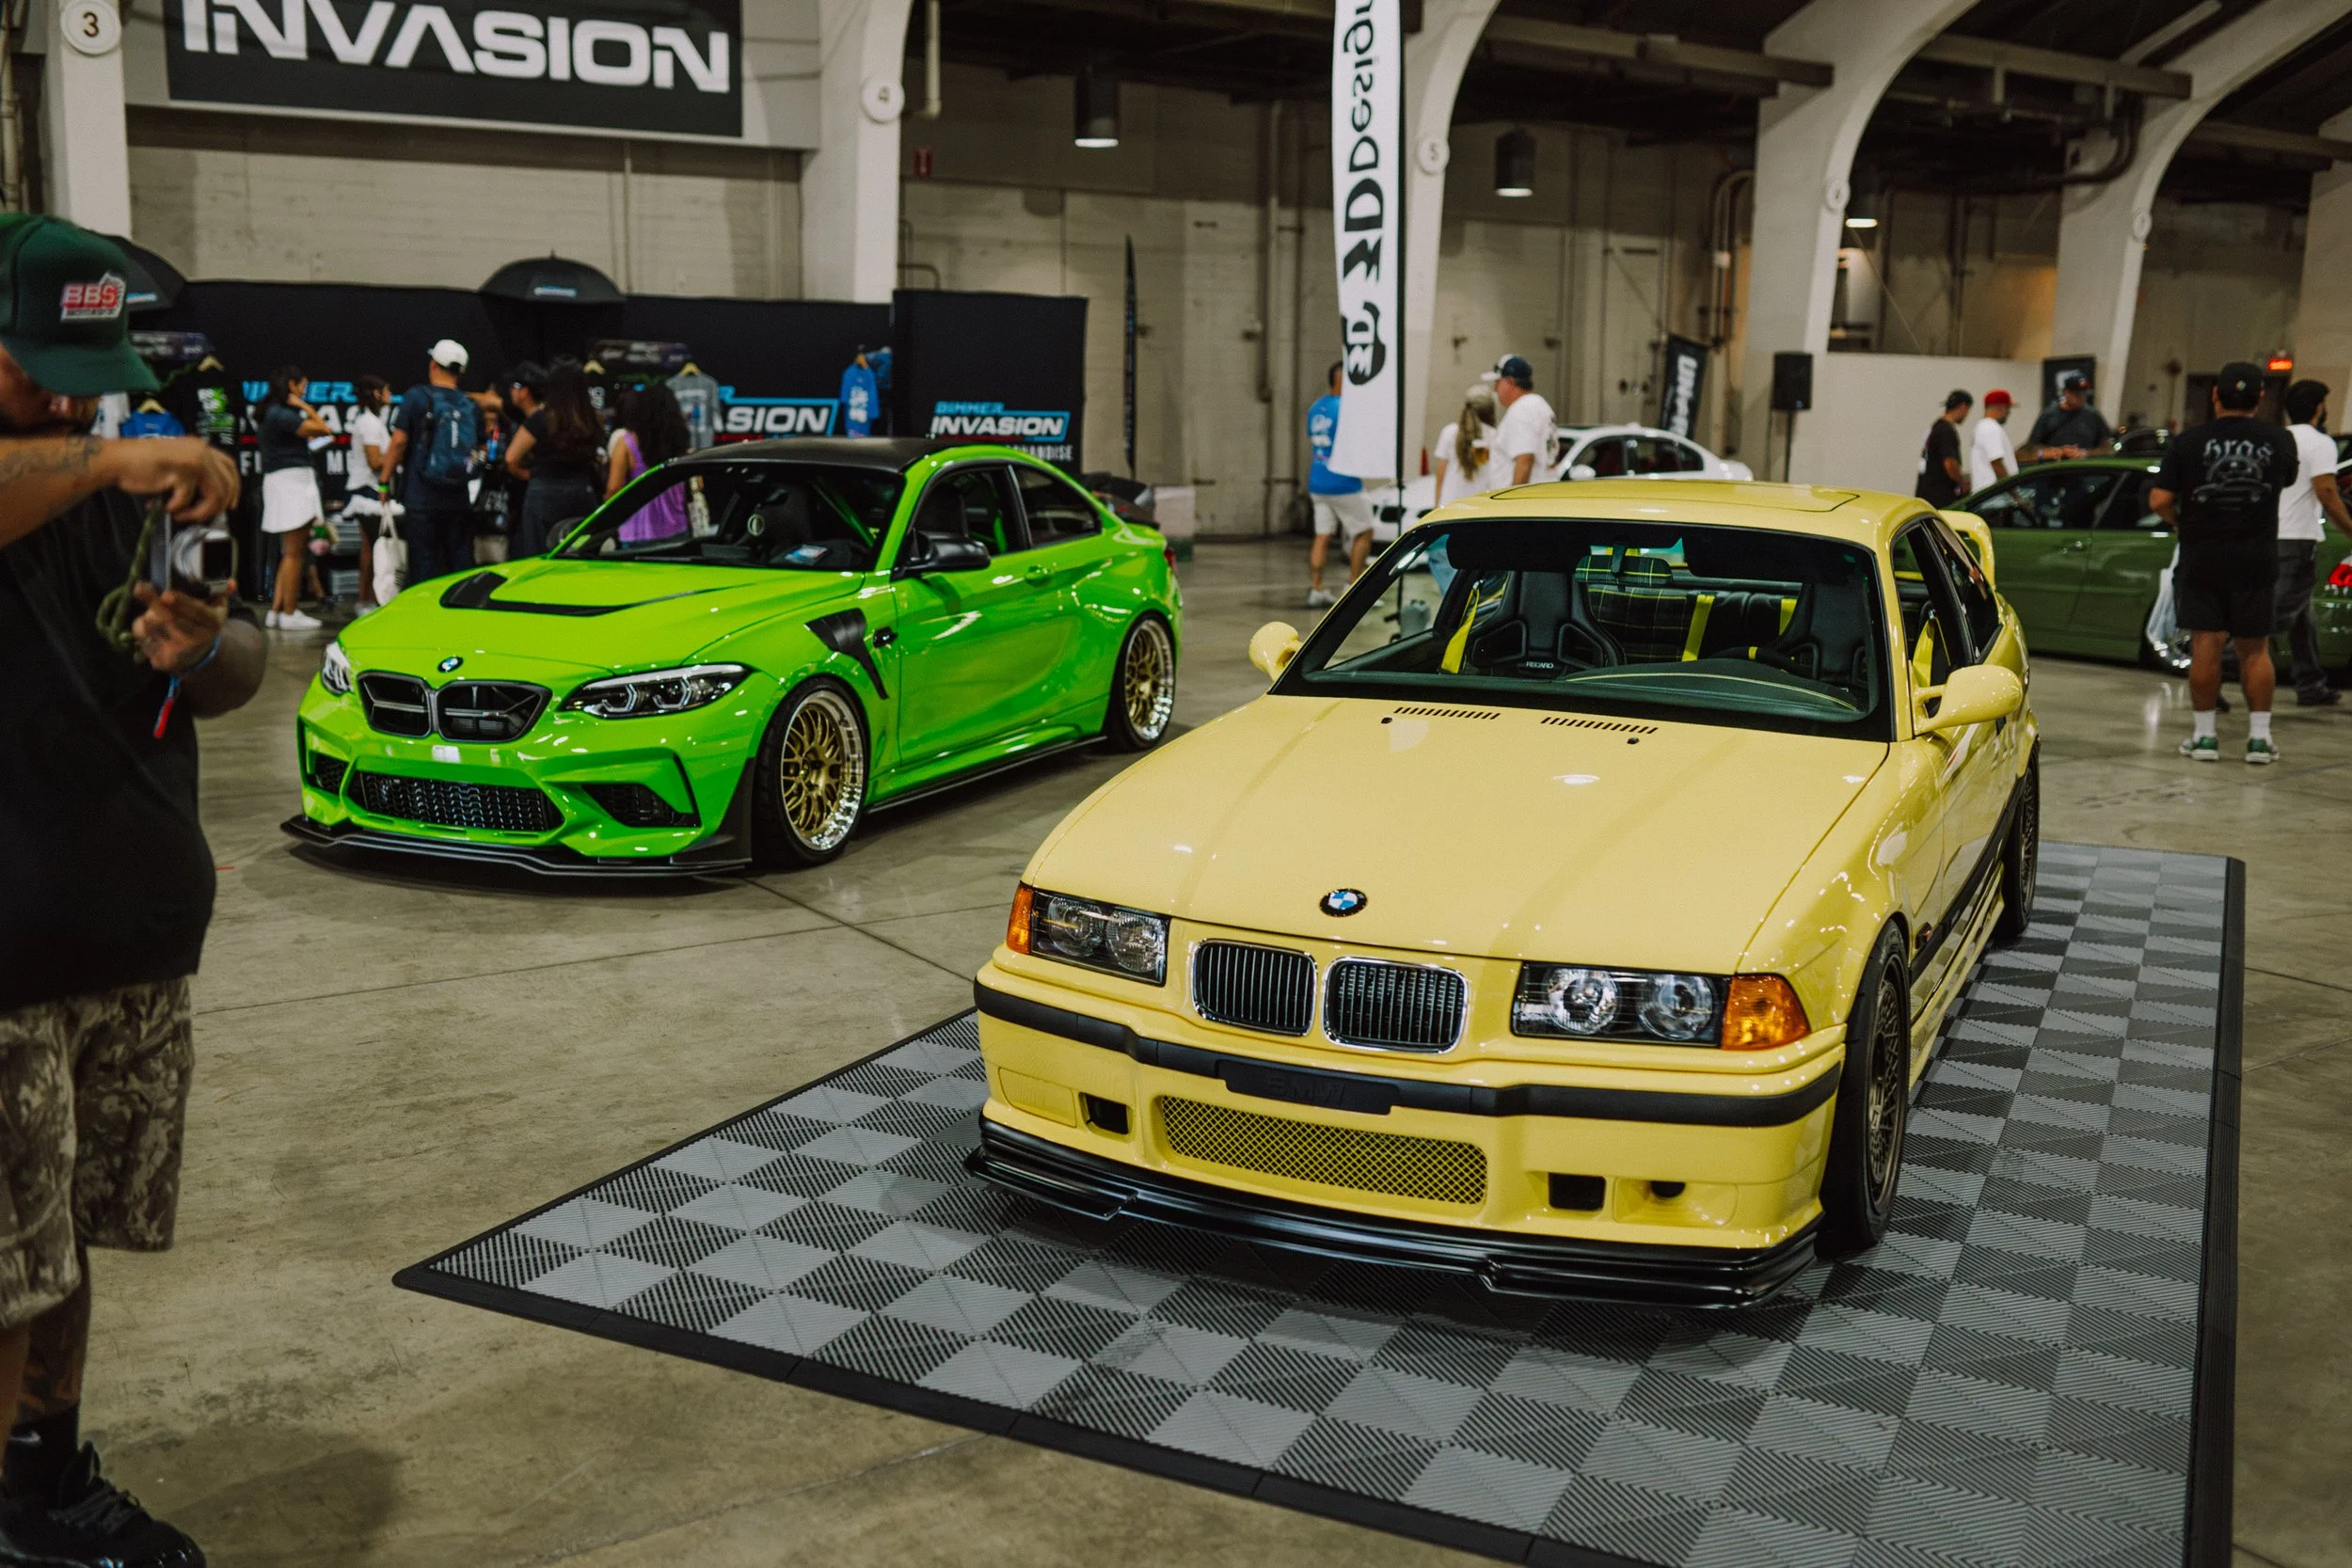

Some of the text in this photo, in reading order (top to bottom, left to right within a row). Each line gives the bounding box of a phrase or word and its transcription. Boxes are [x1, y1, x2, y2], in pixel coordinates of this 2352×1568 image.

[82, 11, 99, 38] 3
[183, 0, 730, 93] INVASION
[63, 283, 118, 308] BBS
[930, 416, 1064, 436] INVASION
